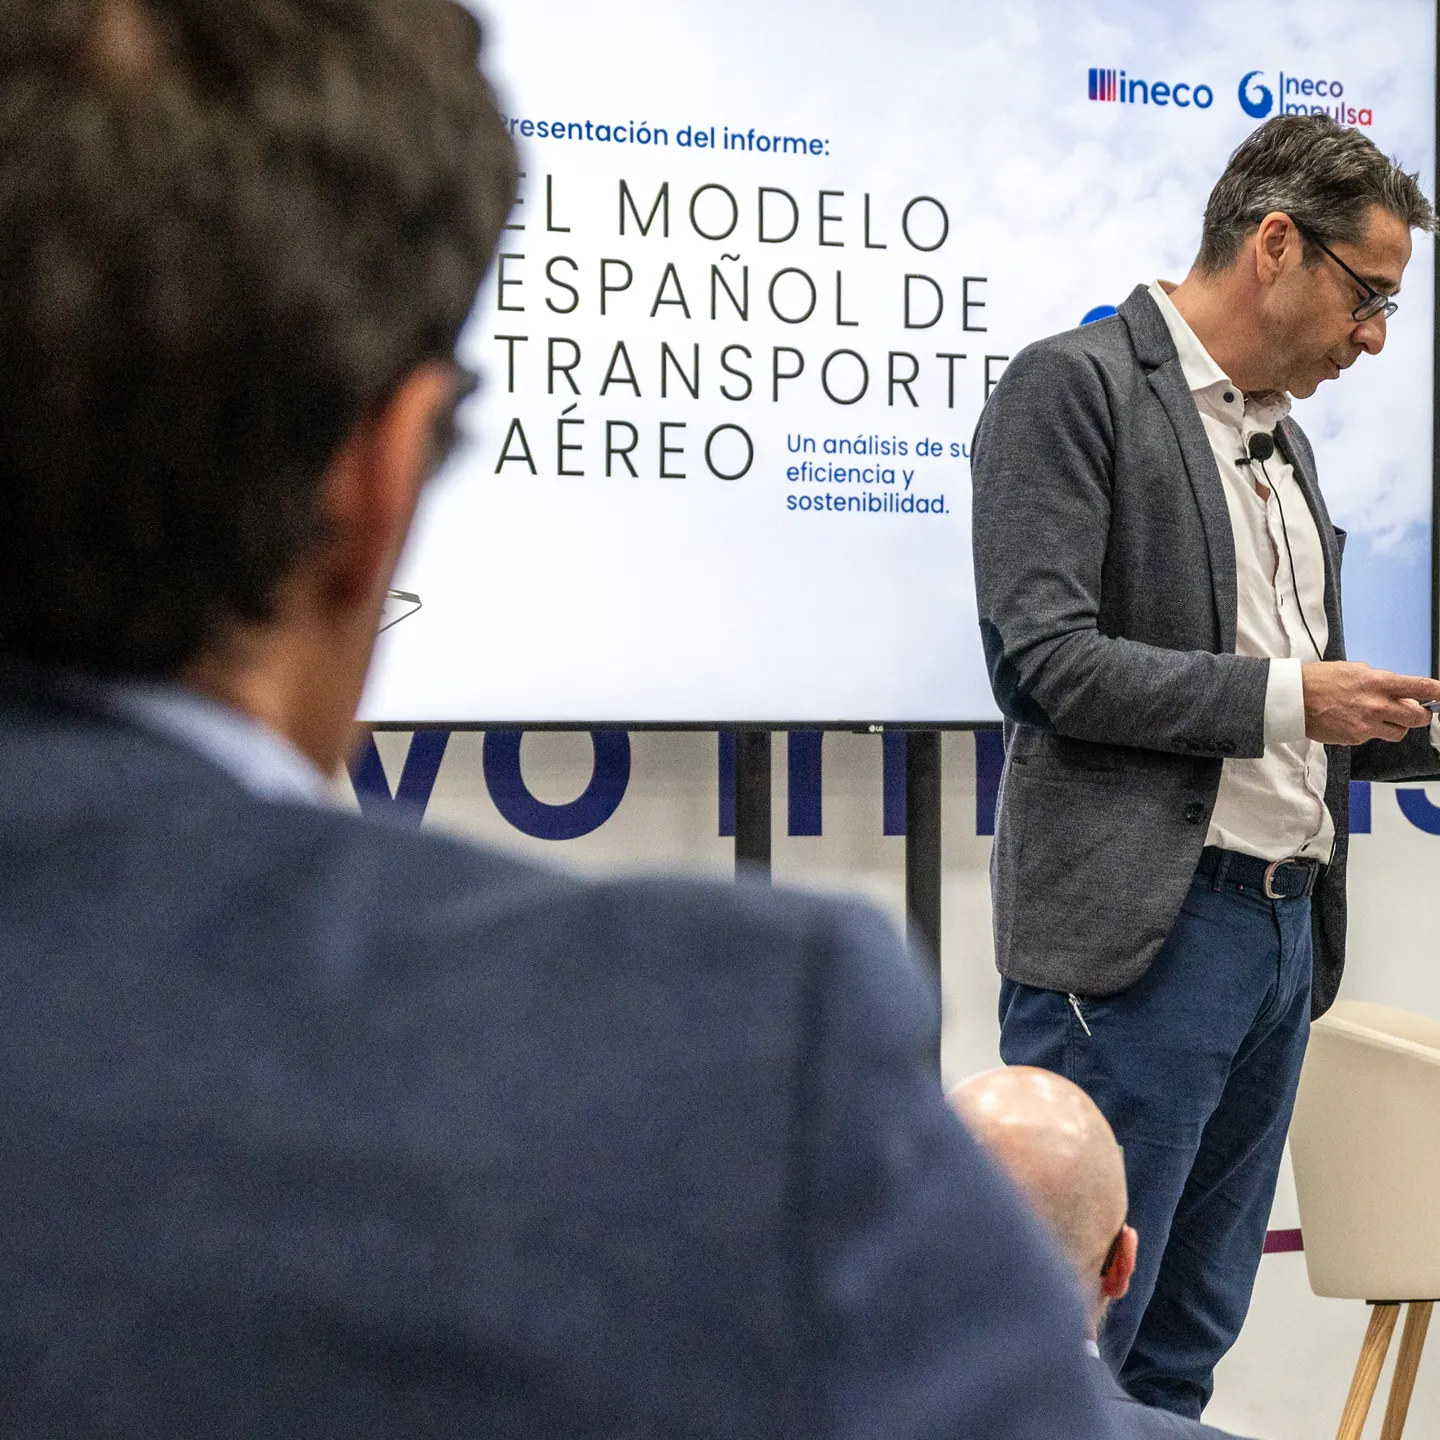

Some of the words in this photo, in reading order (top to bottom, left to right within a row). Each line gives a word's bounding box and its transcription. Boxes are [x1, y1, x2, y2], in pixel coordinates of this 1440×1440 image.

[1120, 71, 1213, 108] ineco
[676, 125, 715, 149] del
[723, 126, 830, 156] informe:
[618, 178, 949, 252] MODELO
[496, 253, 859, 327] ESPAÑOL
[904, 274, 988, 333] DE
[495, 403, 754, 481] AÉREO
[787, 434, 816, 453] Un
[823, 434, 908, 456] análisis
[915, 438, 943, 457] de
[786, 461, 895, 484] eficiencia
[902, 469, 915, 491] y
[786, 491, 950, 514] sostenibilidad.
